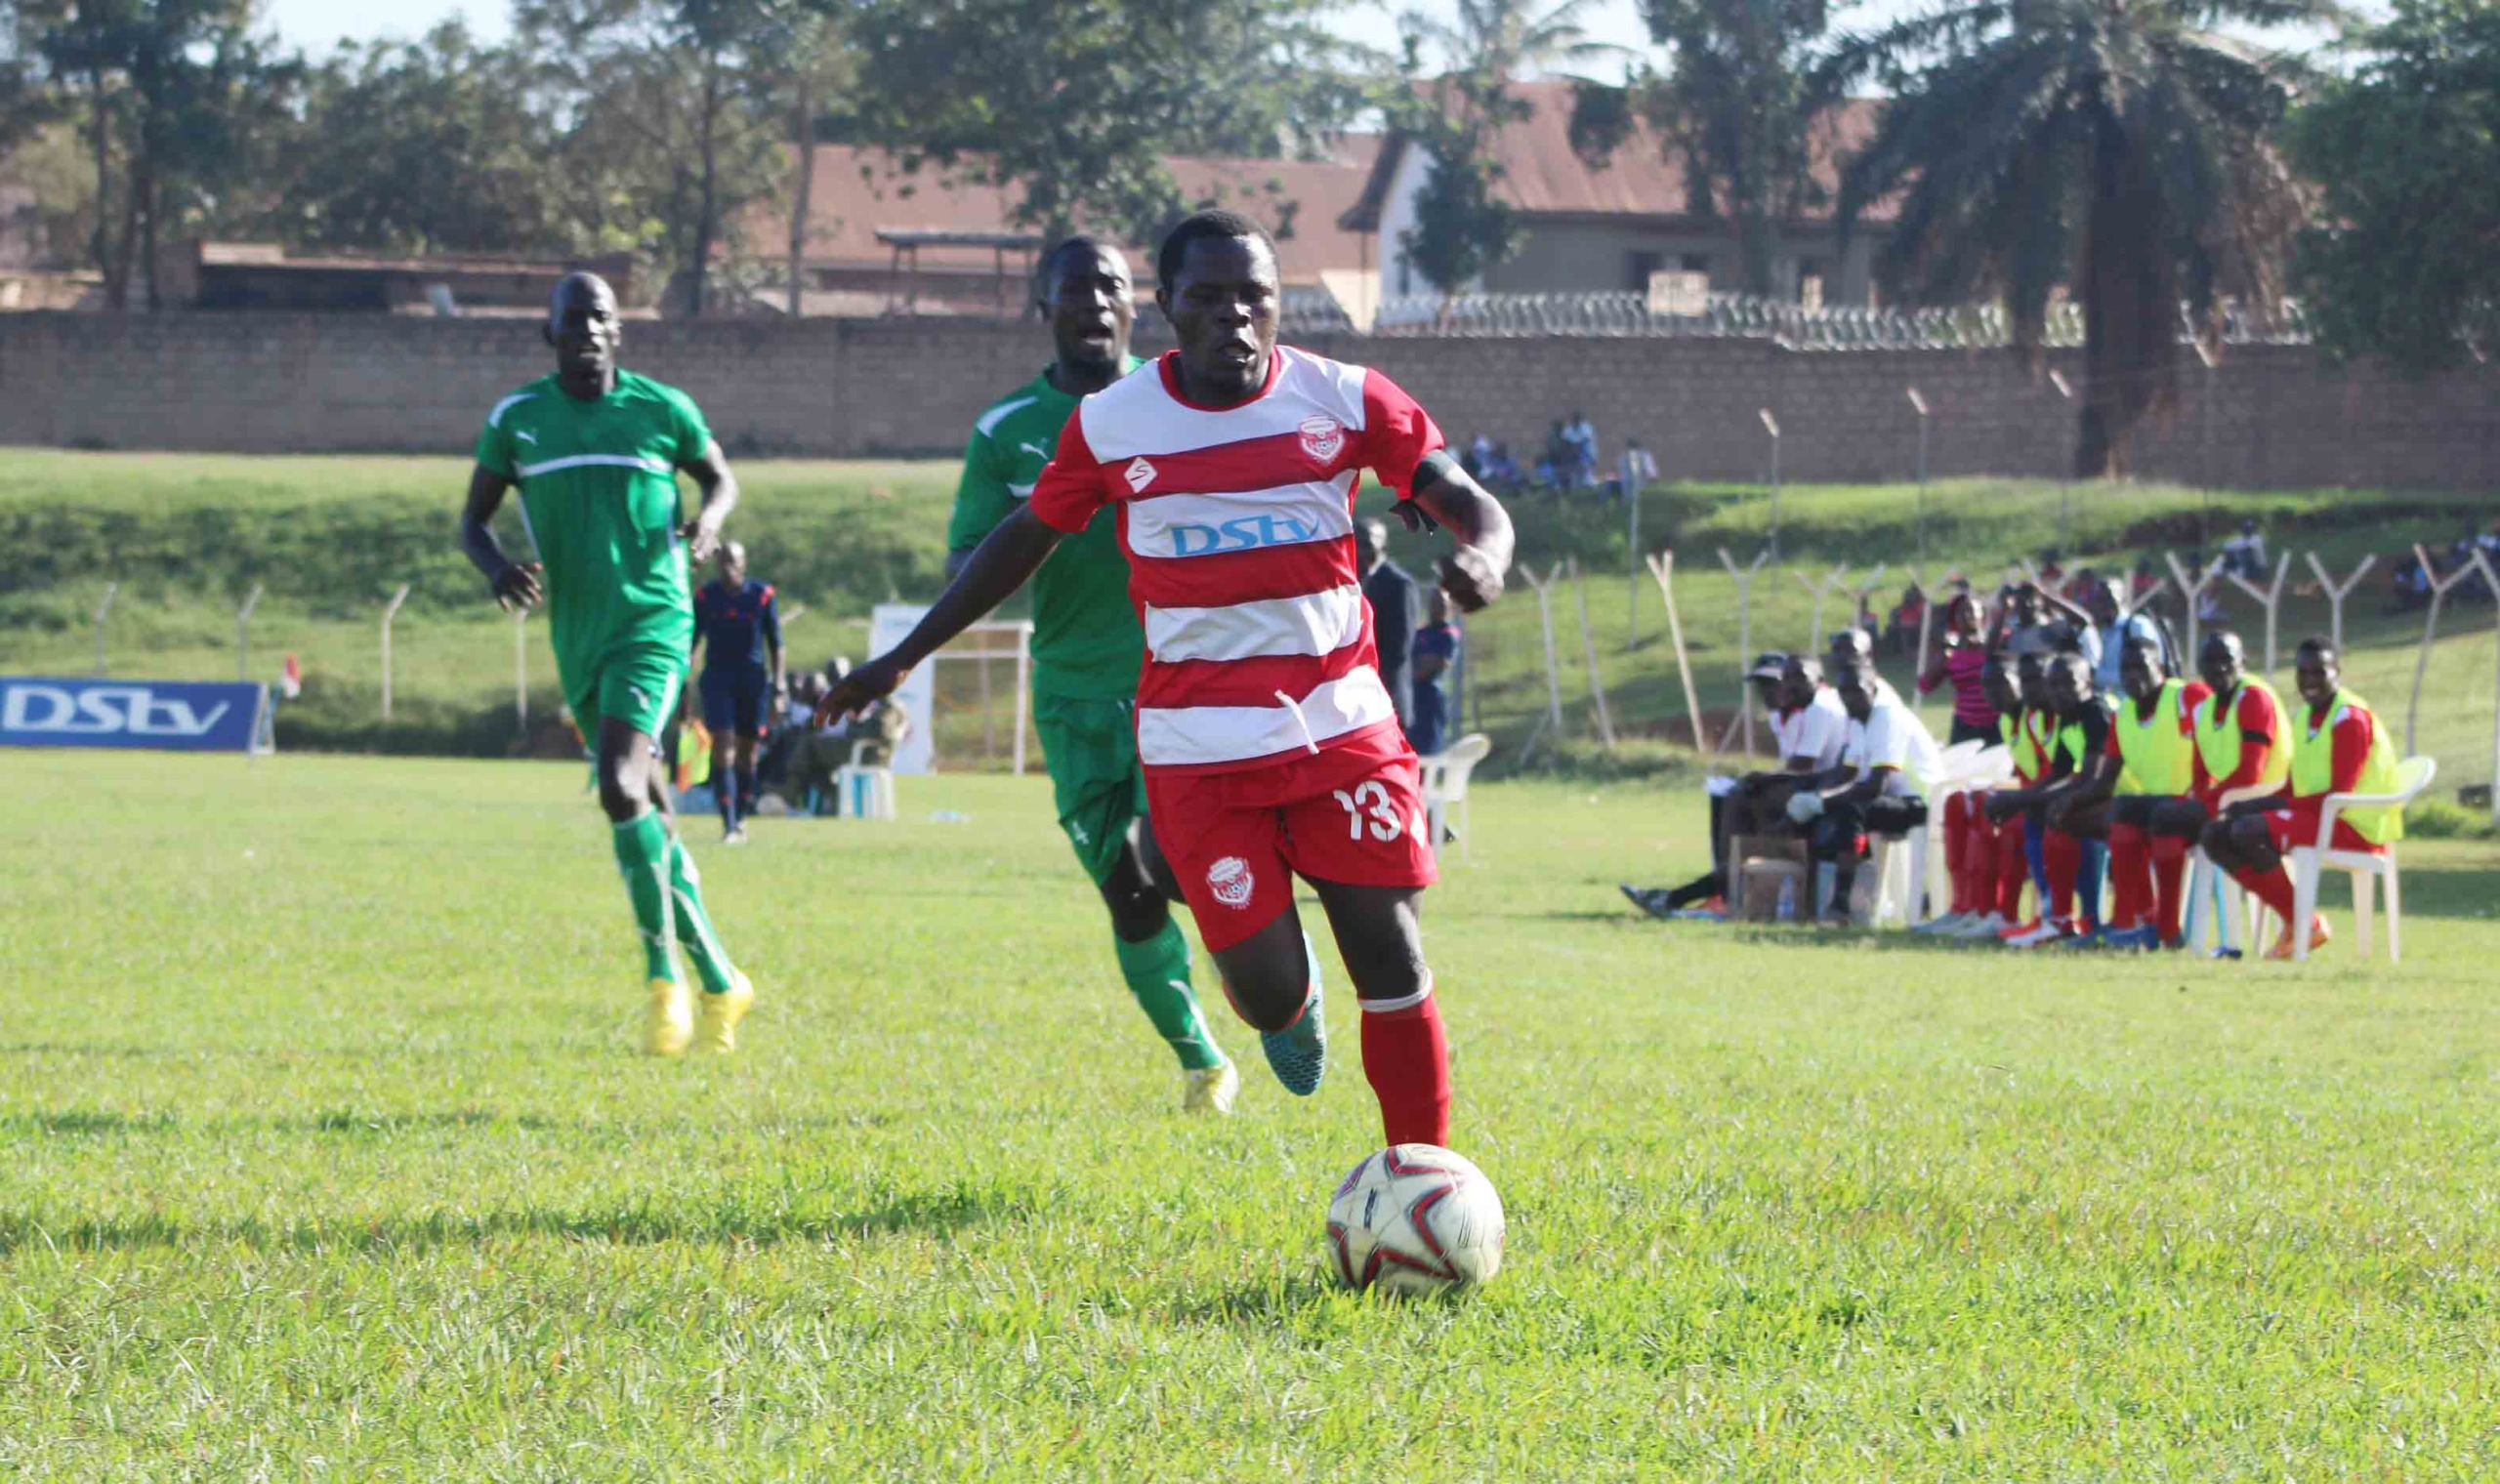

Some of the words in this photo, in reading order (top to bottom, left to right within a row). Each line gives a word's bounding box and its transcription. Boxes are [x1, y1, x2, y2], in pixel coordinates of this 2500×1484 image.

[1173, 515, 1318, 556] DStv
[2, 686, 230, 735] DStv
[1333, 780, 1401, 843] 13
